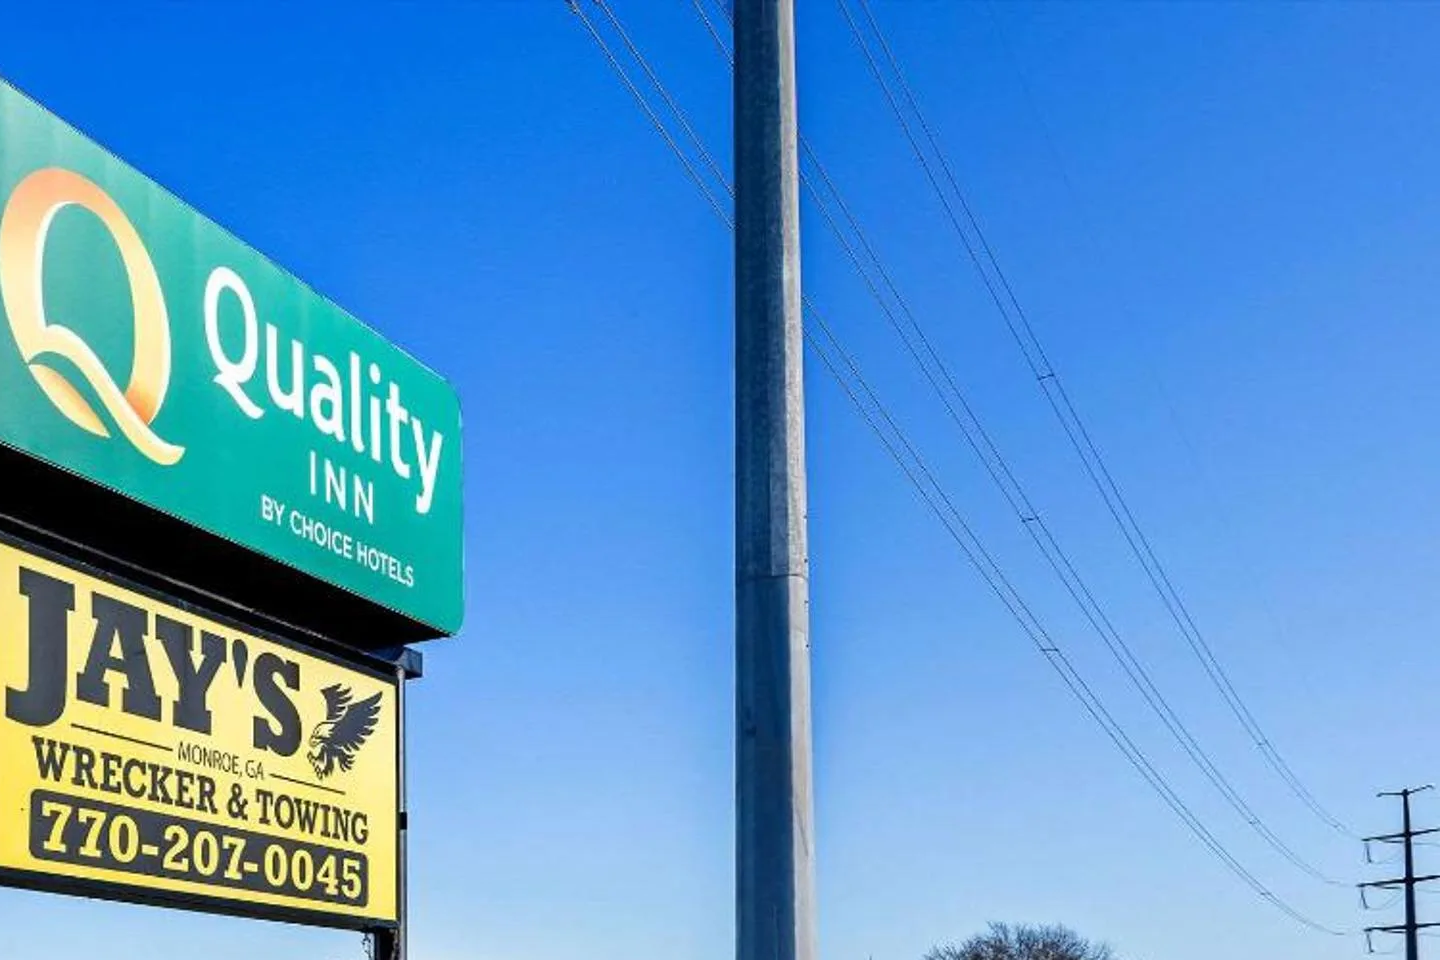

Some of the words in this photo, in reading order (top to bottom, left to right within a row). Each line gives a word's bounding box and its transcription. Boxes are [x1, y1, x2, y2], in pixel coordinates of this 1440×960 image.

[203, 266, 443, 514] Quality
[309, 450, 374, 524] INN
[261, 493, 286, 524] BY
[290, 511, 353, 560] CHOICE
[356, 541, 414, 587] HOTELS
[5, 566, 303, 757] JAY'S
[31, 735, 219, 815] WRECKER
[228, 783, 249, 821] &
[256, 789, 369, 845] TOWING
[177, 741, 243, 779] MONROE,
[245, 757, 265, 780] GA
[41, 801, 362, 898] 770-207-0045
